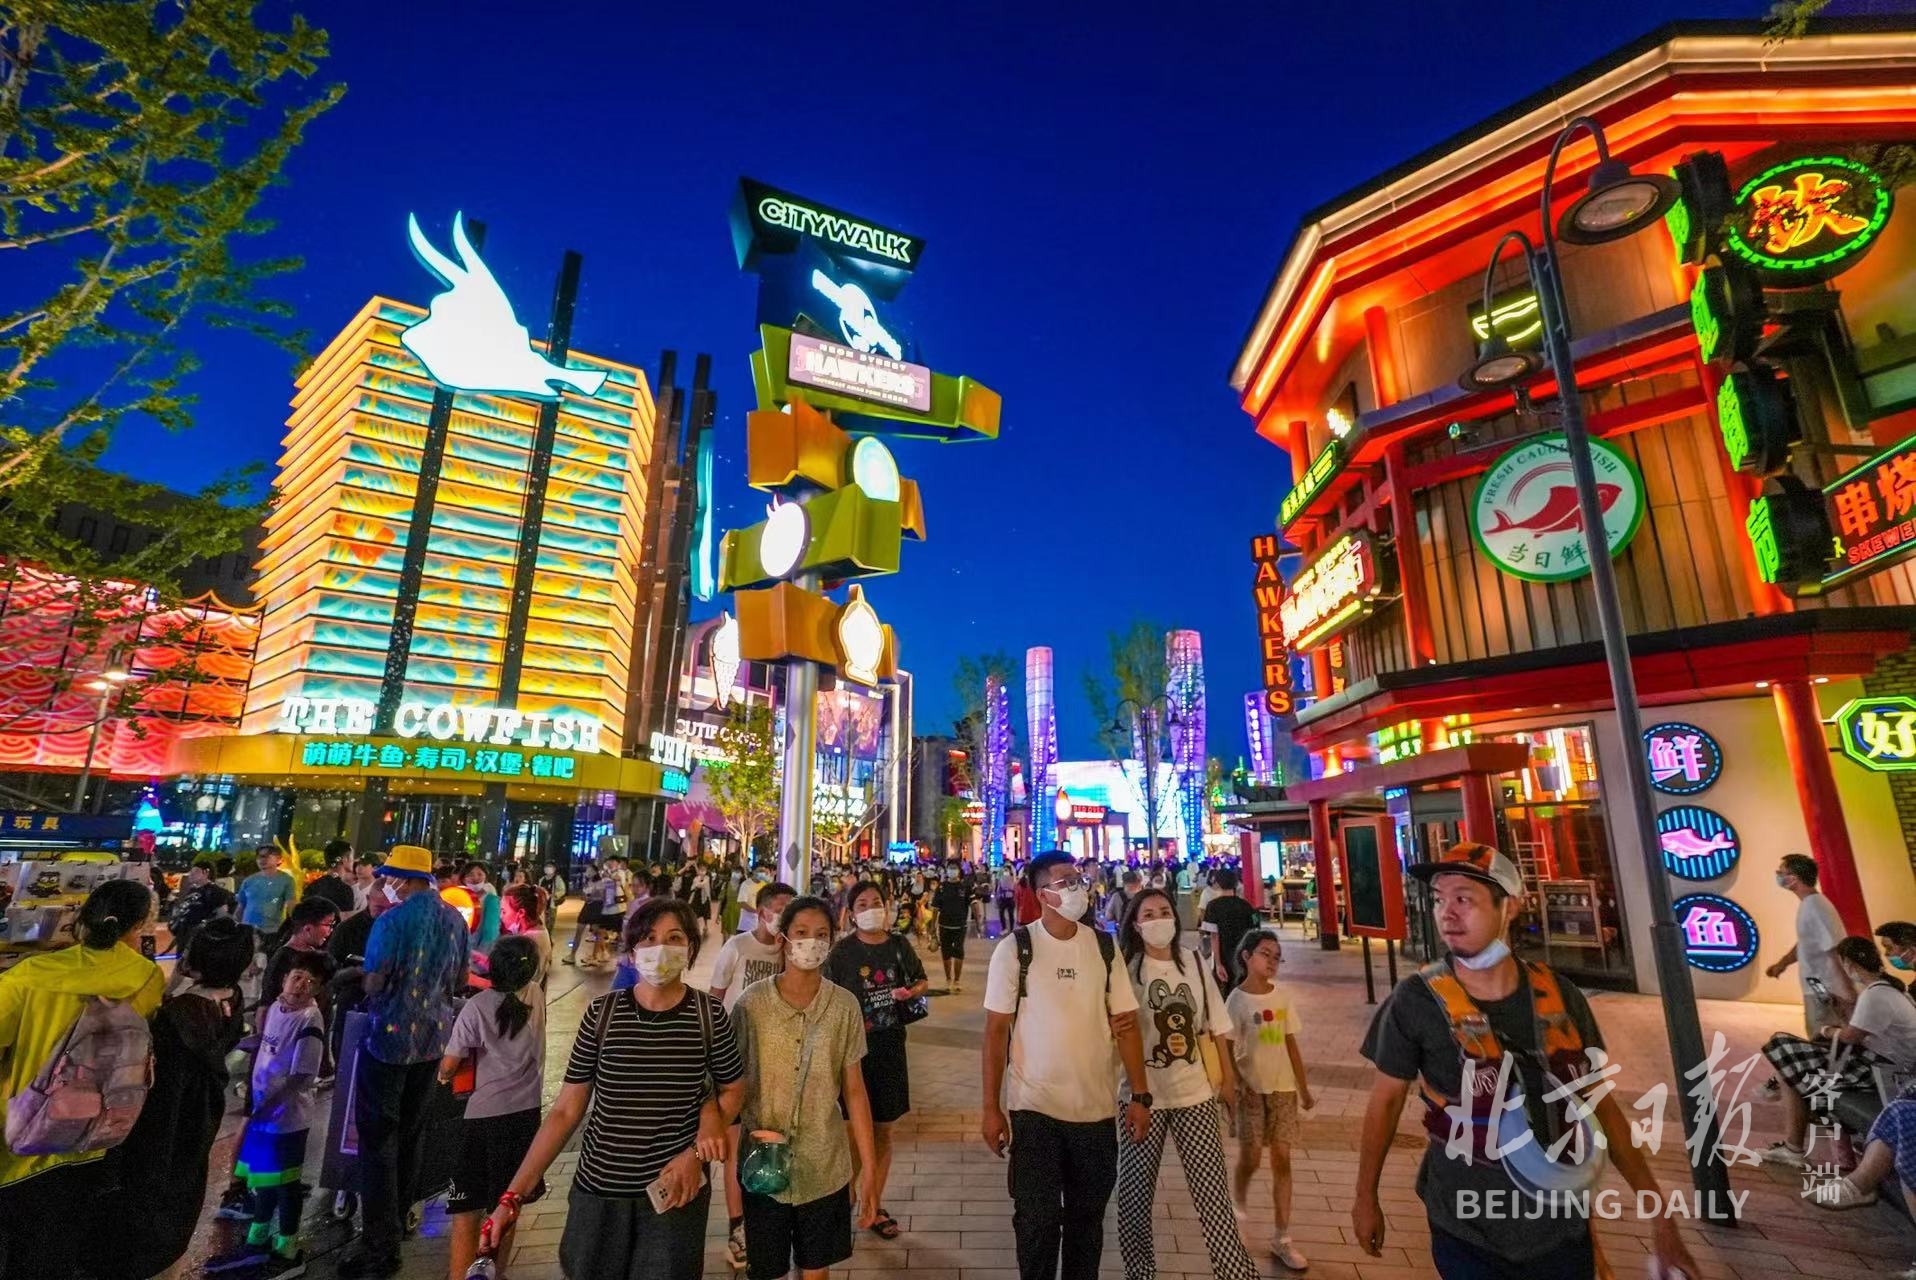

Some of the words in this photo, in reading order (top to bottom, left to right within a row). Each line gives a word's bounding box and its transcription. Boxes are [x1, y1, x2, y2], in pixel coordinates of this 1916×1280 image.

[759, 198, 911, 263] CITYWALK
[1484, 463, 1515, 504] FRESH
[1834, 451, 1916, 537] 串烧
[1848, 518, 1916, 564] SKEWE
[1253, 536, 1291, 714] HAWKERS
[278, 696, 375, 735] THE
[393, 702, 603, 754] COWFISH
[1858, 711, 1916, 759] 好
[1648, 735, 1706, 782] 鲜
[0, 816, 60, 831] 玩具
[1682, 906, 1746, 956] 鱼
